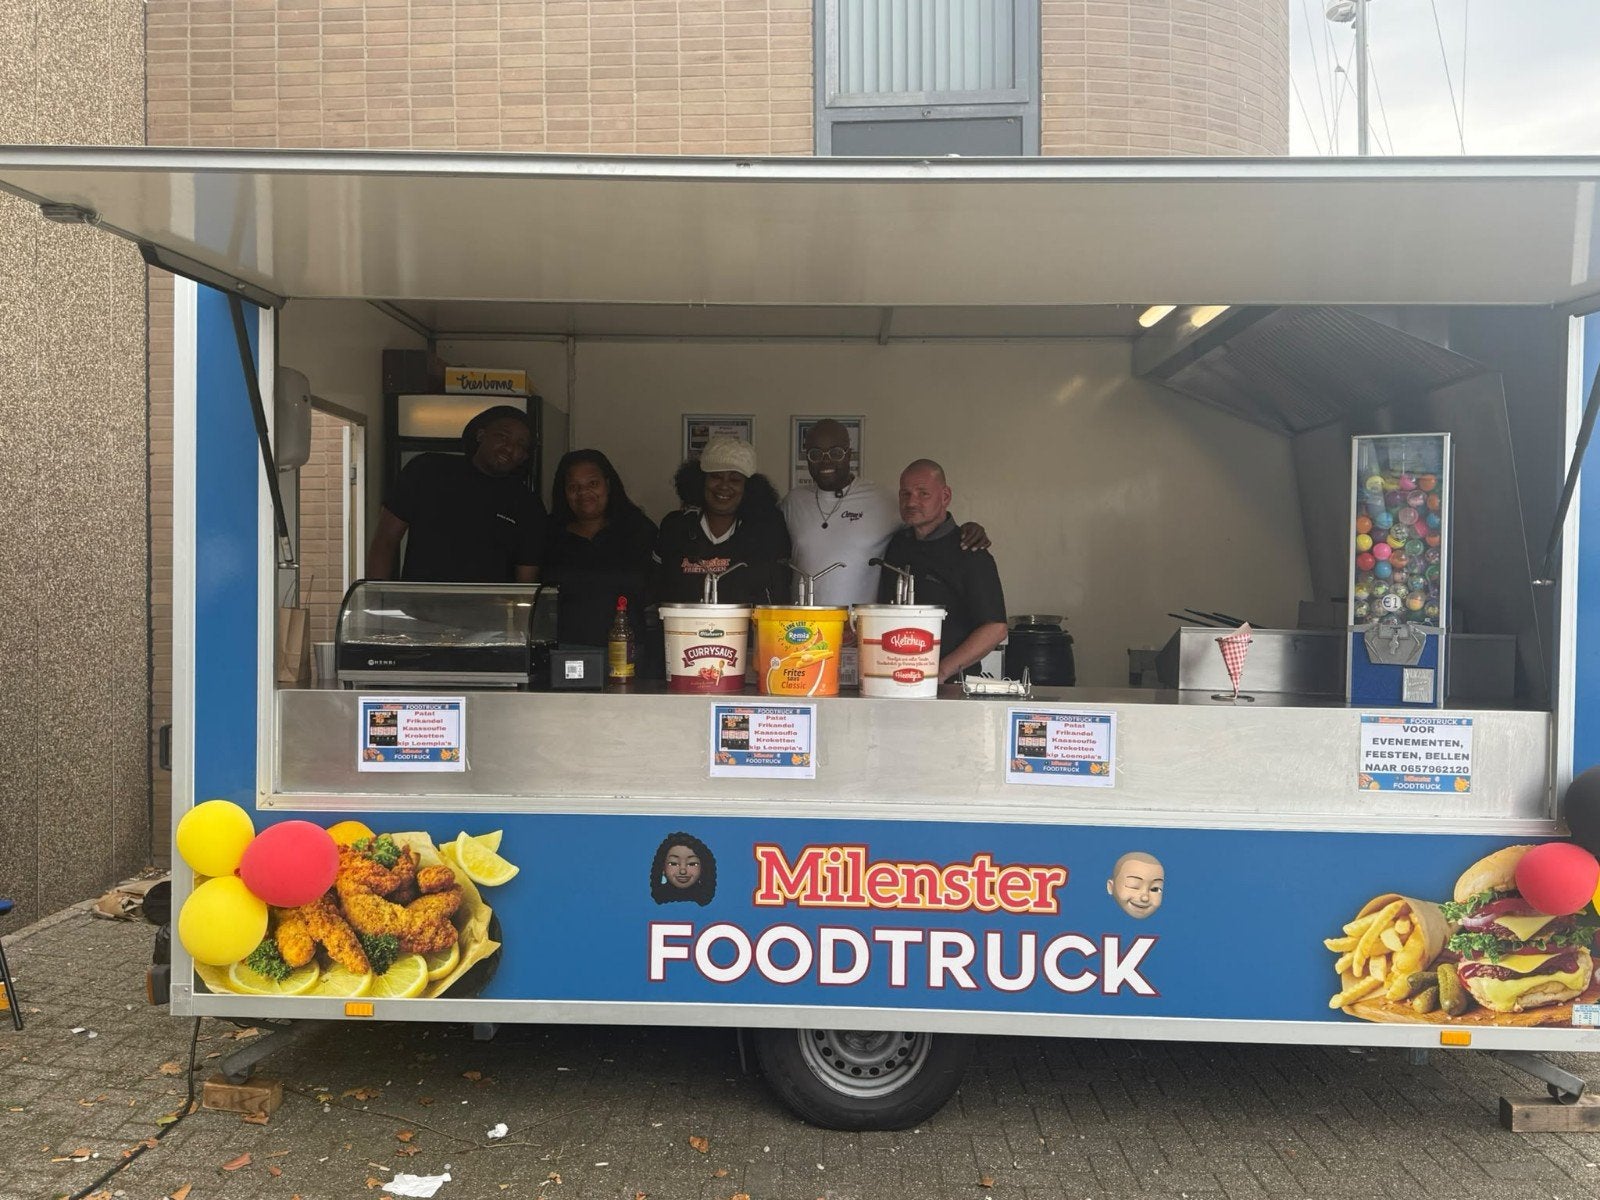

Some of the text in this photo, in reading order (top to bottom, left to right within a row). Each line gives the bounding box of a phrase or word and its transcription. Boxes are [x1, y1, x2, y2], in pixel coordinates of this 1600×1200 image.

[788, 632, 810, 640] Remia
[890, 633, 927, 652] Ketchup
[688, 646, 734, 659] CURRYSAUS
[783, 668, 806, 677] Frites
[781, 681, 807, 689] Classic
[1402, 725, 1435, 733] VOOR
[1372, 737, 1464, 749] EVENEMENTEN,
[1365, 750, 1470, 761] FEESTEN, BELLEN
[1365, 763, 1469, 774] NAAR 0657962120
[1393, 782, 1441, 790] FOODTRUCK
[754, 842, 1068, 915] Milenster
[649, 923, 1158, 997] FOODTRUCK
